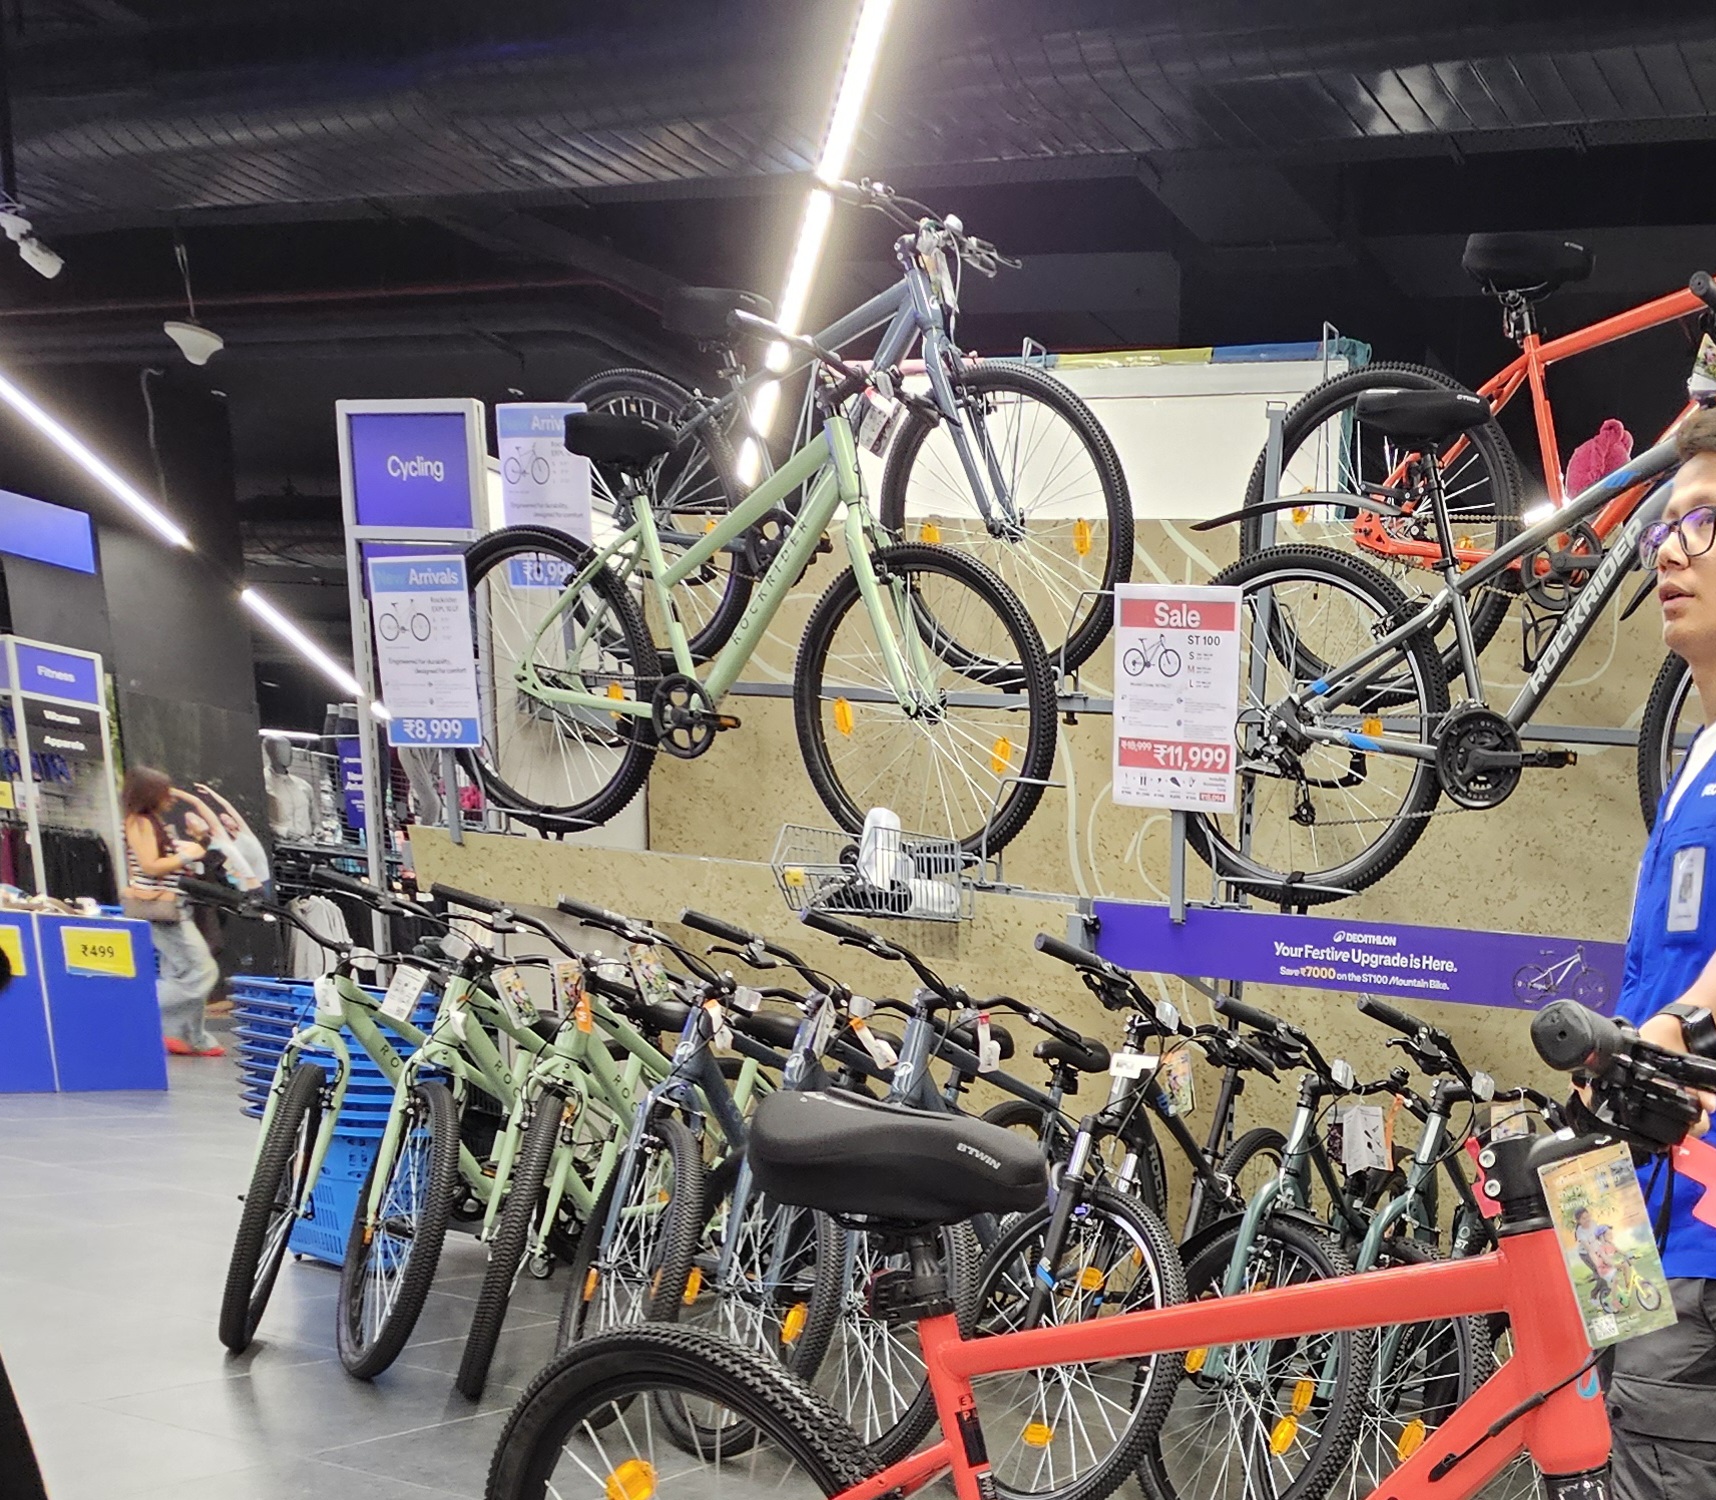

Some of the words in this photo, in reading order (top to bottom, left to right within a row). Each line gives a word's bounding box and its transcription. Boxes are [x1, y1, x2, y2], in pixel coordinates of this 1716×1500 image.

[531, 415, 561, 431] Arriv
[387, 456, 445, 483] Cycling
[409, 567, 459, 585] Arrivals
[732, 522, 808, 645] ROCKRIDER
[1154, 601, 1201, 628] Sale
[1187, 635, 1201, 646] ST
[1203, 636, 1221, 646] 100
[36, 665, 76, 683] Fitness
[403, 719, 463, 742] ₹8,999
[1153, 744, 1227, 771] ₹11,999
[80, 943, 115, 959] ₹499
[1346, 933, 1397, 946] DECATHLON
[1273, 941, 1303, 958] Your
[1304, 944, 1351, 963] Festive
[1351, 948, 1408, 968] Upgrade
[1409, 953, 1420, 969] is
[1422, 955, 1458, 973] Here.
[1279, 966, 1300, 977] Save
[1300, 965, 1336, 980] ₹7000
[1336, 973, 1347, 981] on
[1347, 973, 1361, 983] the
[1362, 973, 1388, 985] ST100
[1388, 976, 1429, 989] Mountain
[956, 1142, 1001, 1170] BTWIN
[1454, 1240, 1469, 1250] ST
